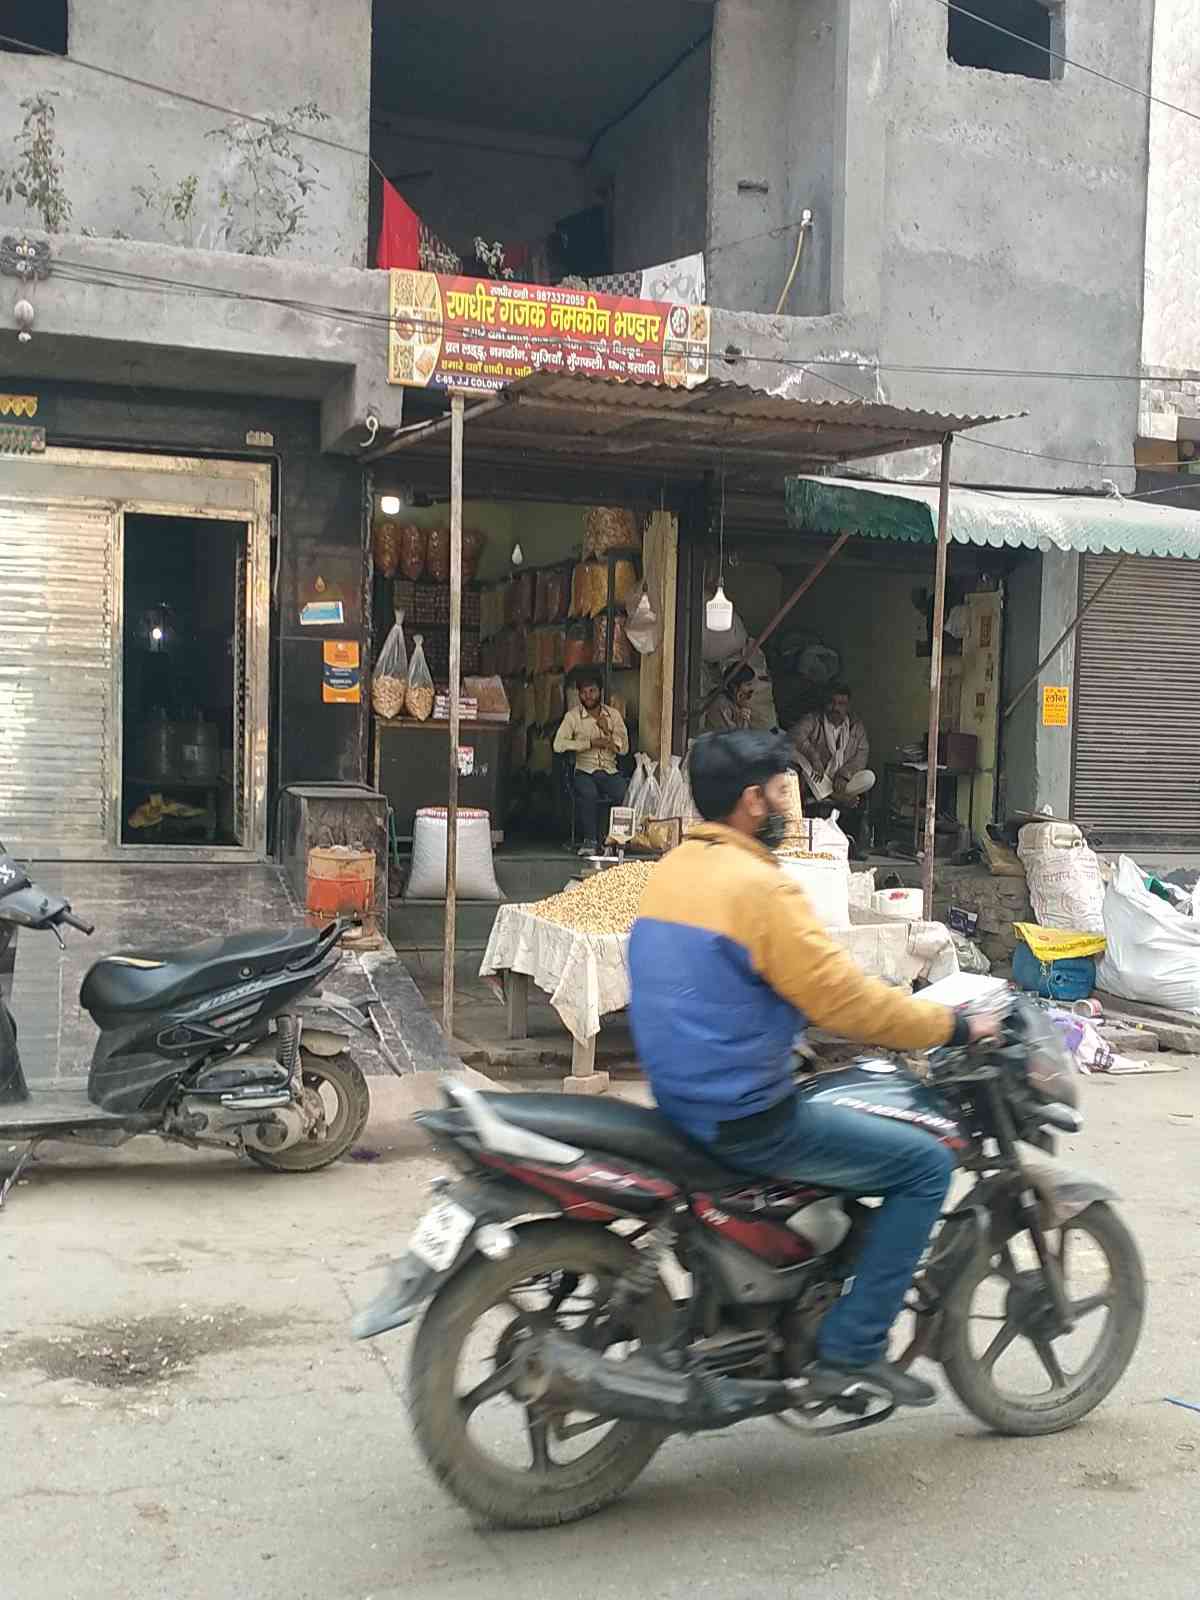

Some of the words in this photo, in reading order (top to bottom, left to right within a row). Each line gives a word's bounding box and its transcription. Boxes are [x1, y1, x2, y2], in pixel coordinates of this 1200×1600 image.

[536, 290, 585, 306] 9873372055
[446, 281, 496, 323] रणधीर
[499, 298, 548, 328] गजक
[551, 295, 611, 337] नमकीन
[614, 310, 661, 344] भण्डार
[489, 345, 528, 362] नमकीन,
[470, 377, 503, 390] COLONY
